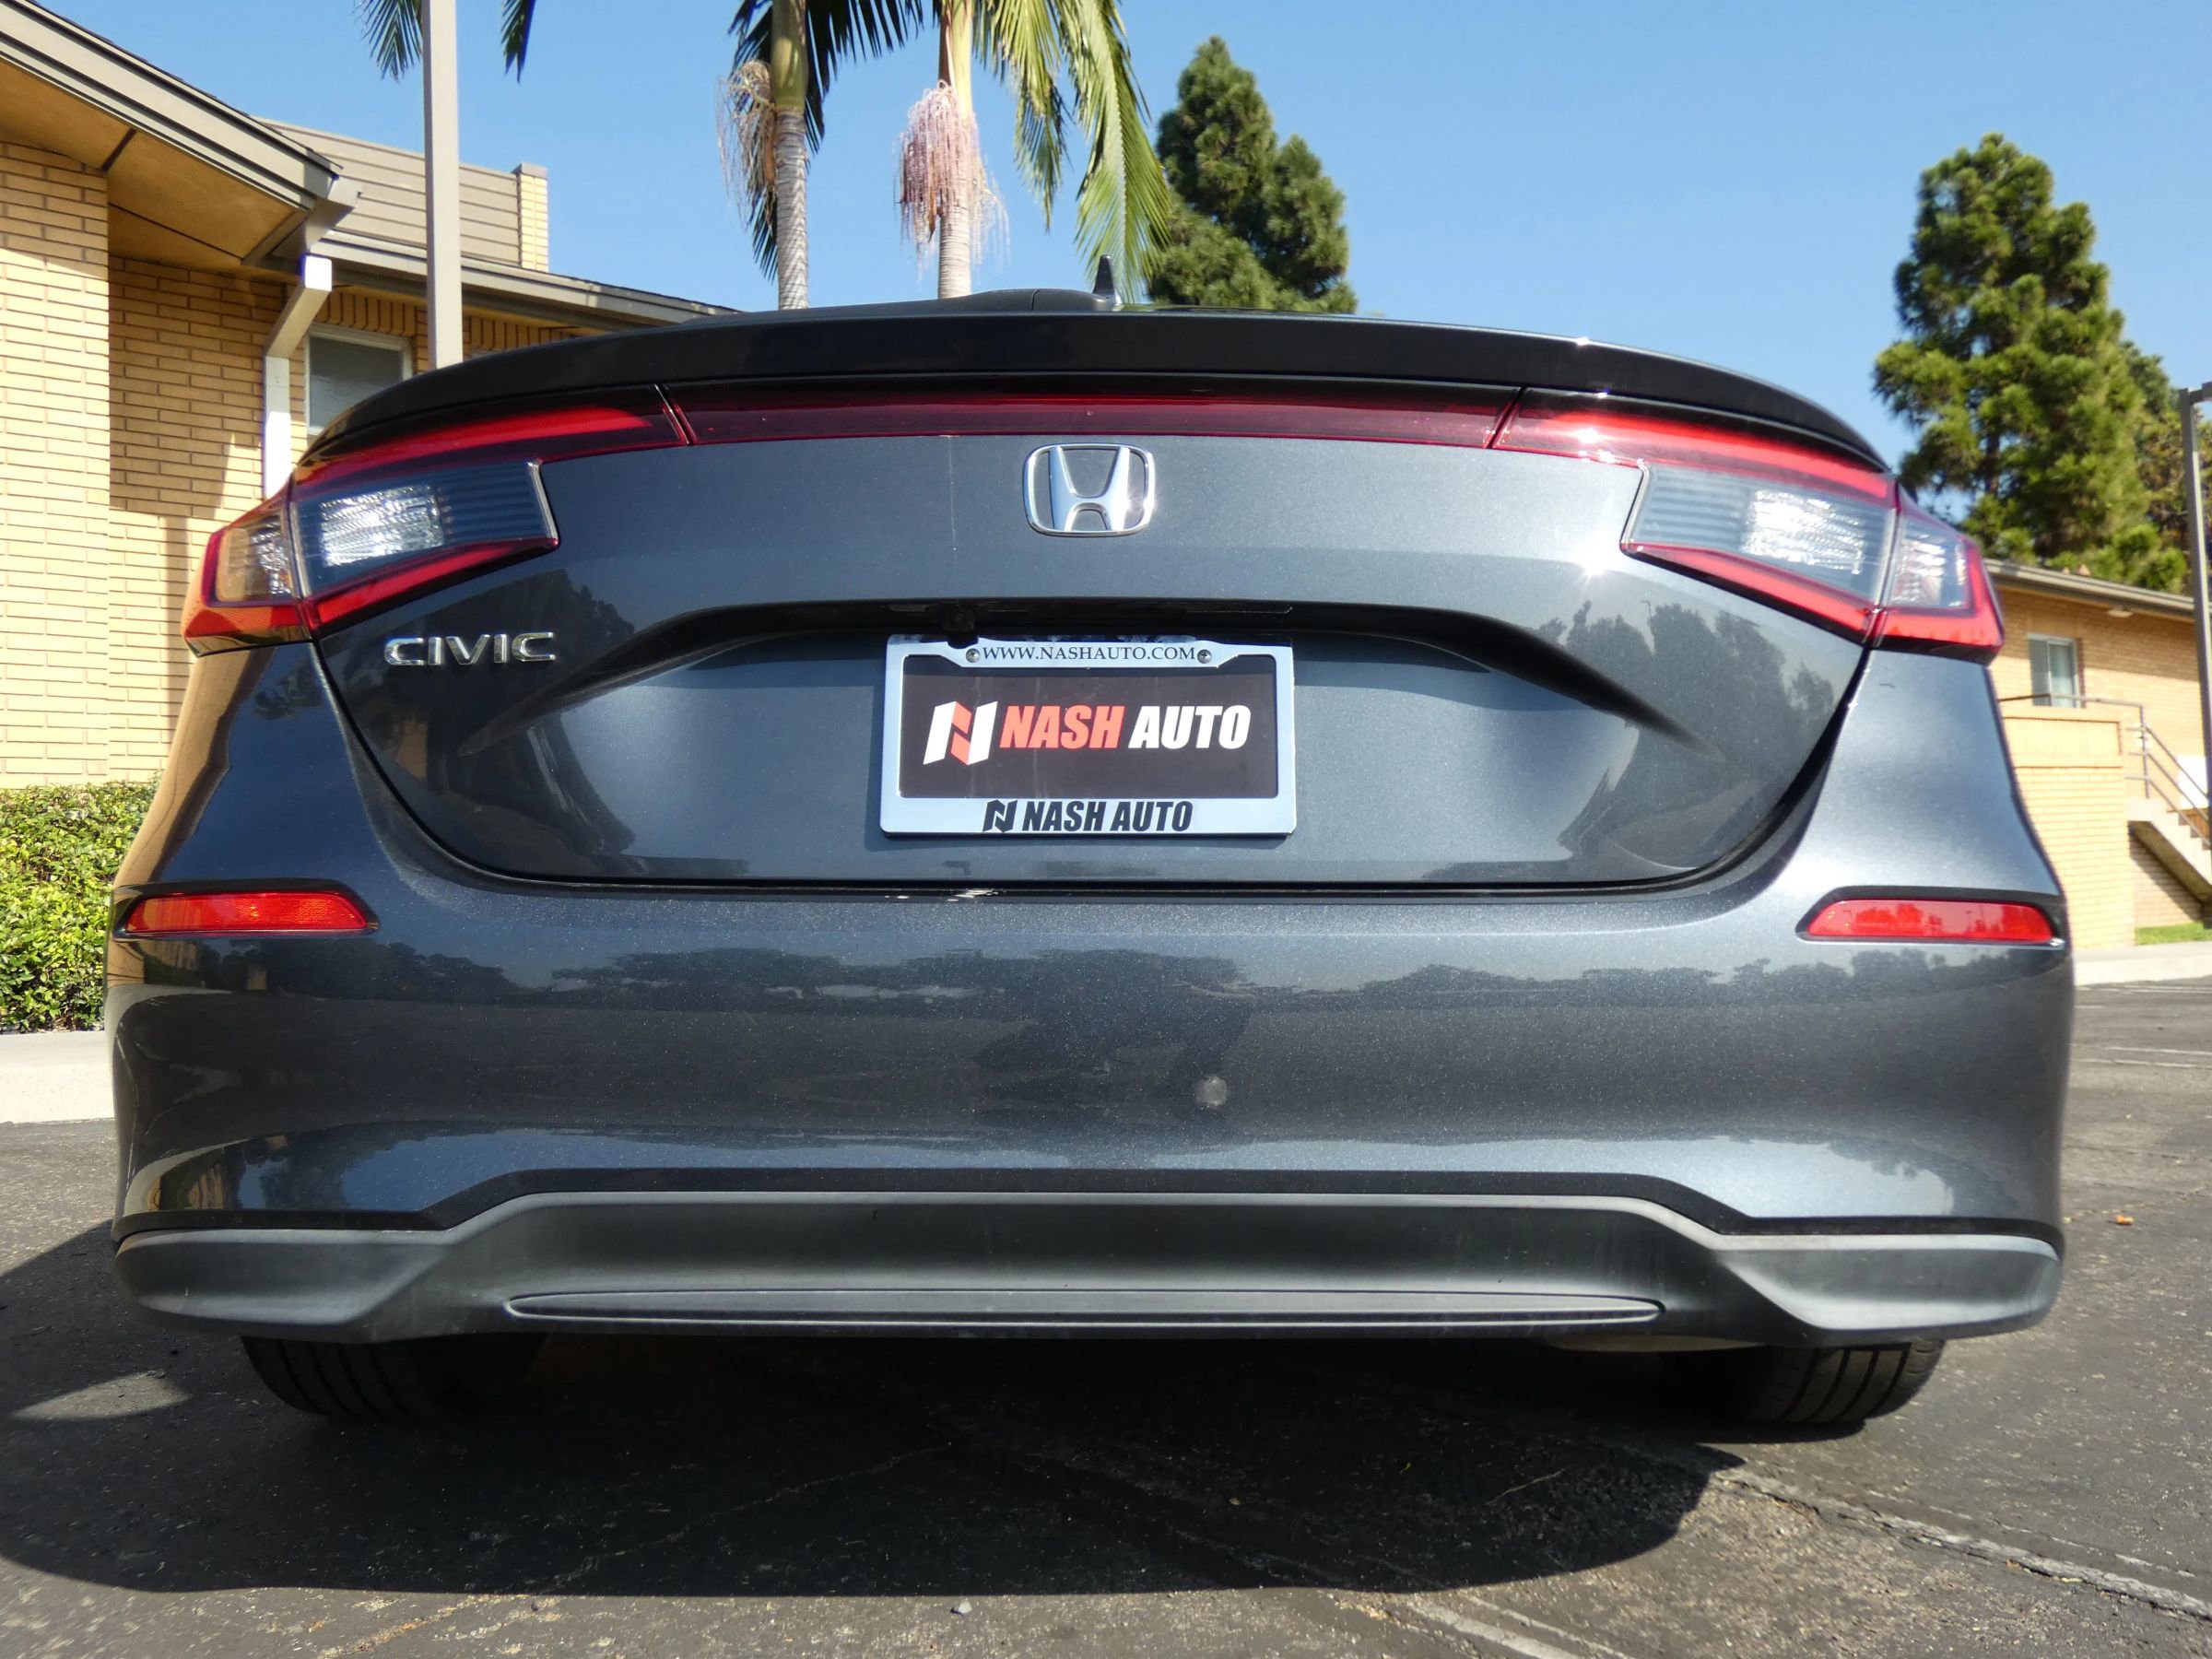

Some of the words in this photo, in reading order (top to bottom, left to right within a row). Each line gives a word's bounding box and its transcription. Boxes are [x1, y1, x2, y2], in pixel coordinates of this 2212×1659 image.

[384, 632, 556, 665] CIVIC
[982, 645, 1196, 661] WWW.NASHAUTO.COM
[999, 704, 1126, 748] NASH
[1128, 704, 1251, 748] AUTO
[1021, 800, 1105, 832] NASH
[1109, 800, 1194, 832] AUTO
